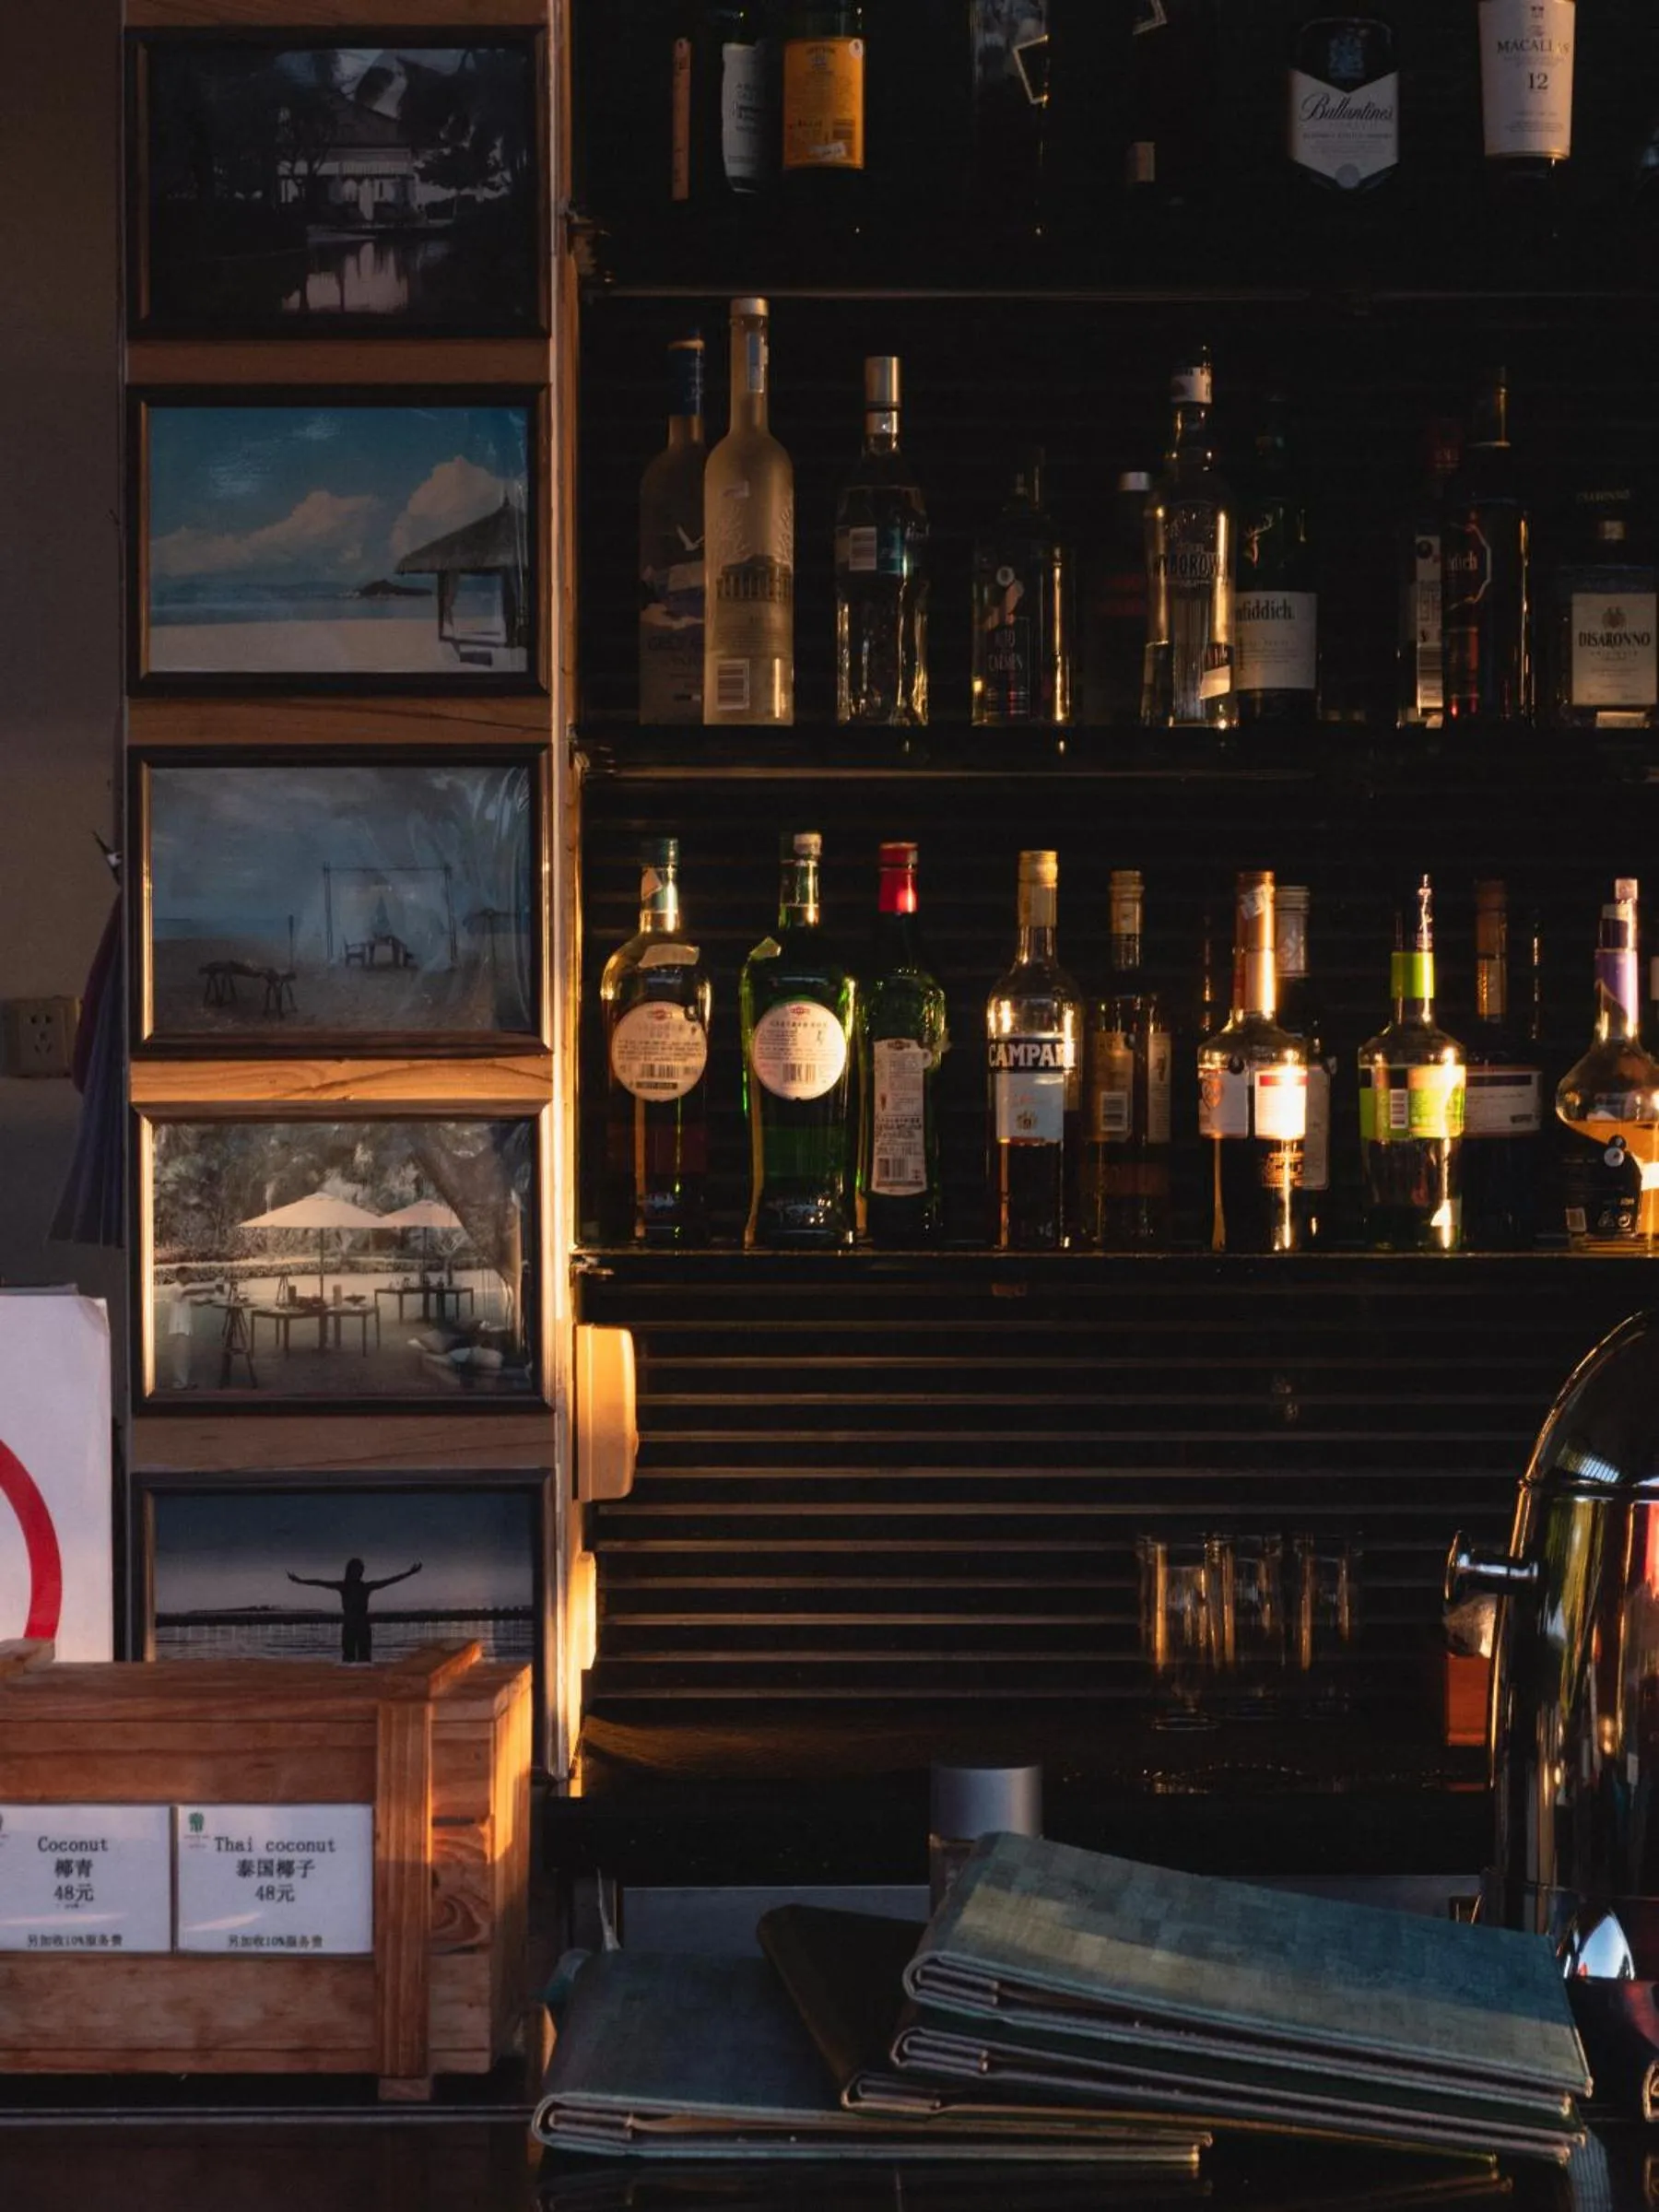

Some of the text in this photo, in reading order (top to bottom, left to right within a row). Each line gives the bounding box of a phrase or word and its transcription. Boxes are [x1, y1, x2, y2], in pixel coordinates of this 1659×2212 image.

[1528, 72, 1549, 90] 12
[1579, 631, 1651, 647] DISARONNO
[988, 1042, 1077, 1067] CAMPARI
[38, 1835, 109, 1853] Coconut
[215, 1836, 253, 1853] Thai
[265, 1838, 336, 1853] coconut
[54, 1858, 93, 1878] 椰青
[236, 1858, 315, 1878] 泰国椰子
[53, 1883, 94, 1901] 48元
[254, 1883, 295, 1902] 48元
